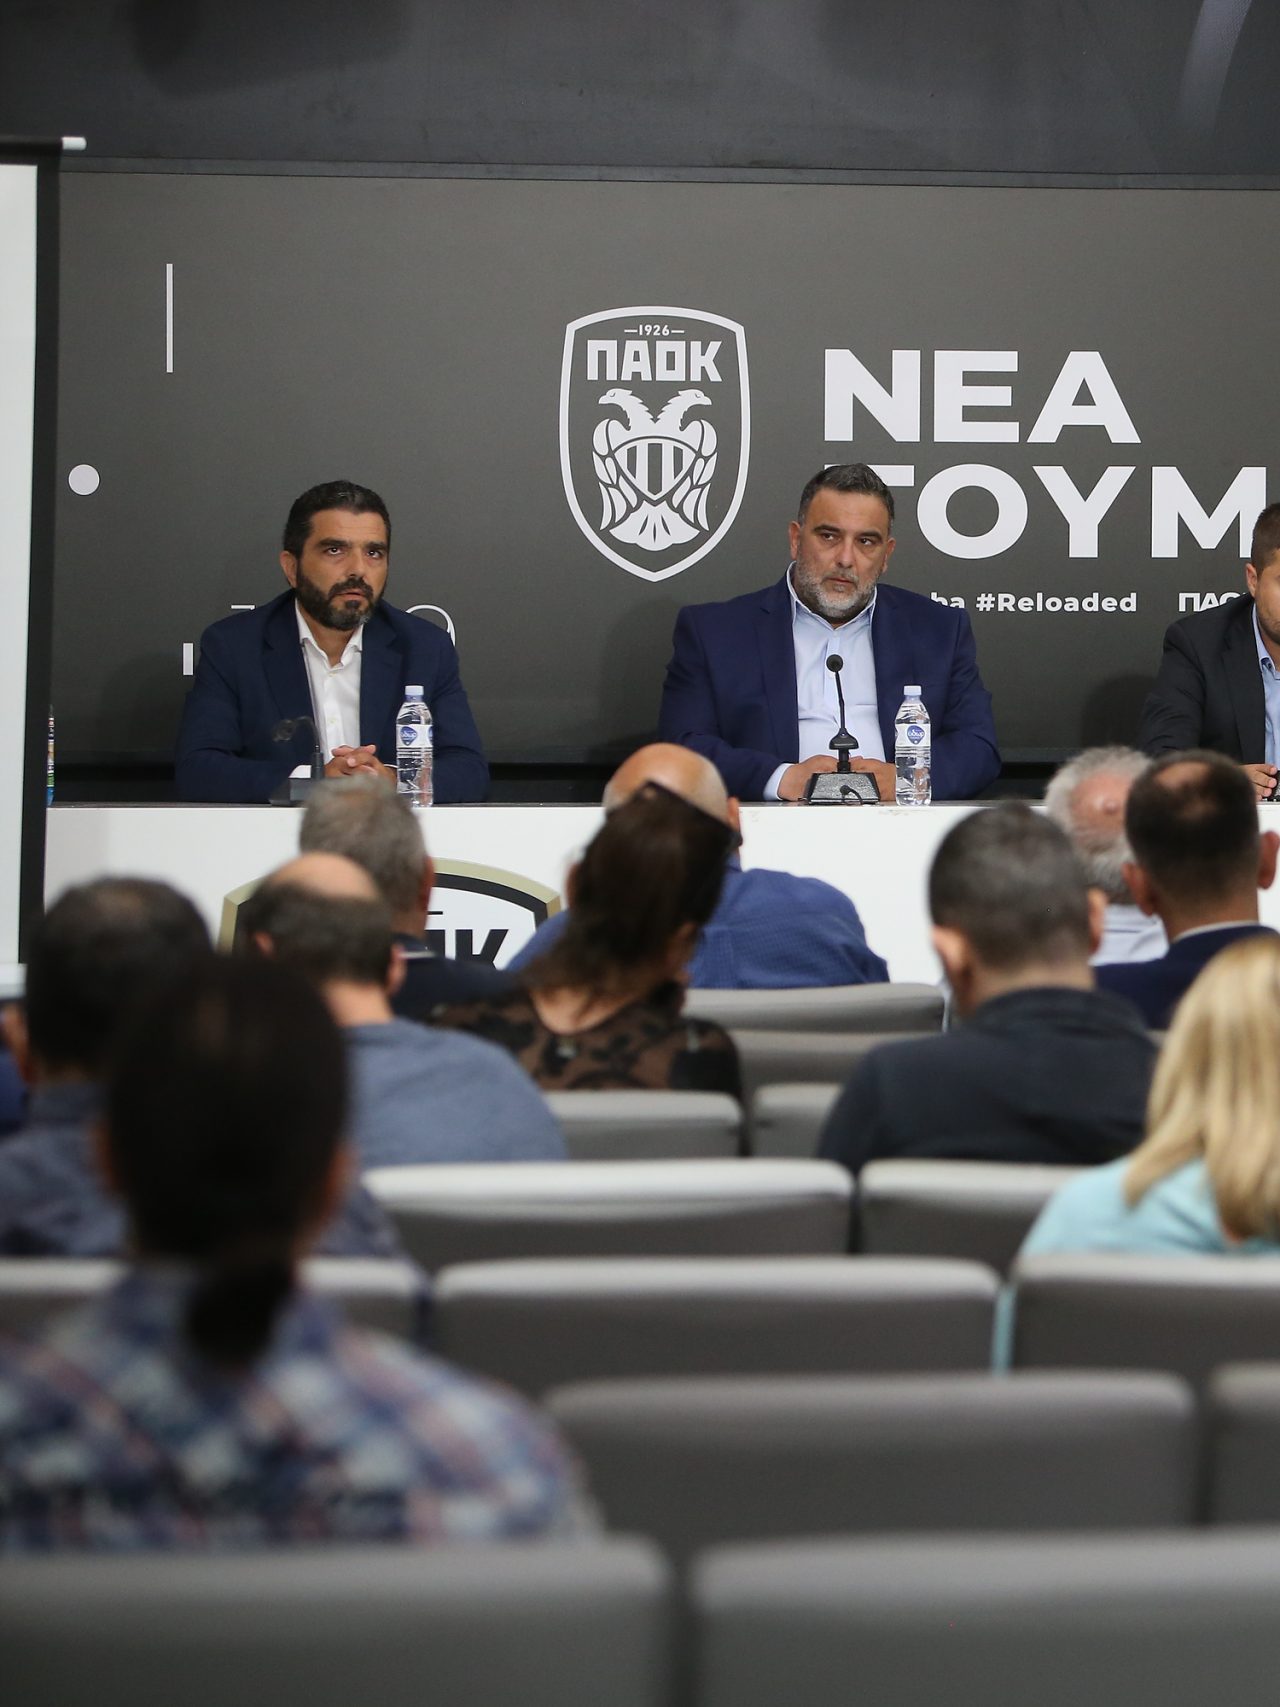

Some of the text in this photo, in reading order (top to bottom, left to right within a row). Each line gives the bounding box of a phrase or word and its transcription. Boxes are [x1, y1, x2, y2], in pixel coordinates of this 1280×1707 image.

[638, 324, 671, 337] 1926
[586, 339, 723, 382] ΠΑΟΚ
[824, 348, 1142, 444] ΝΕΑ
[975, 592, 1137, 612] #Reloaded
